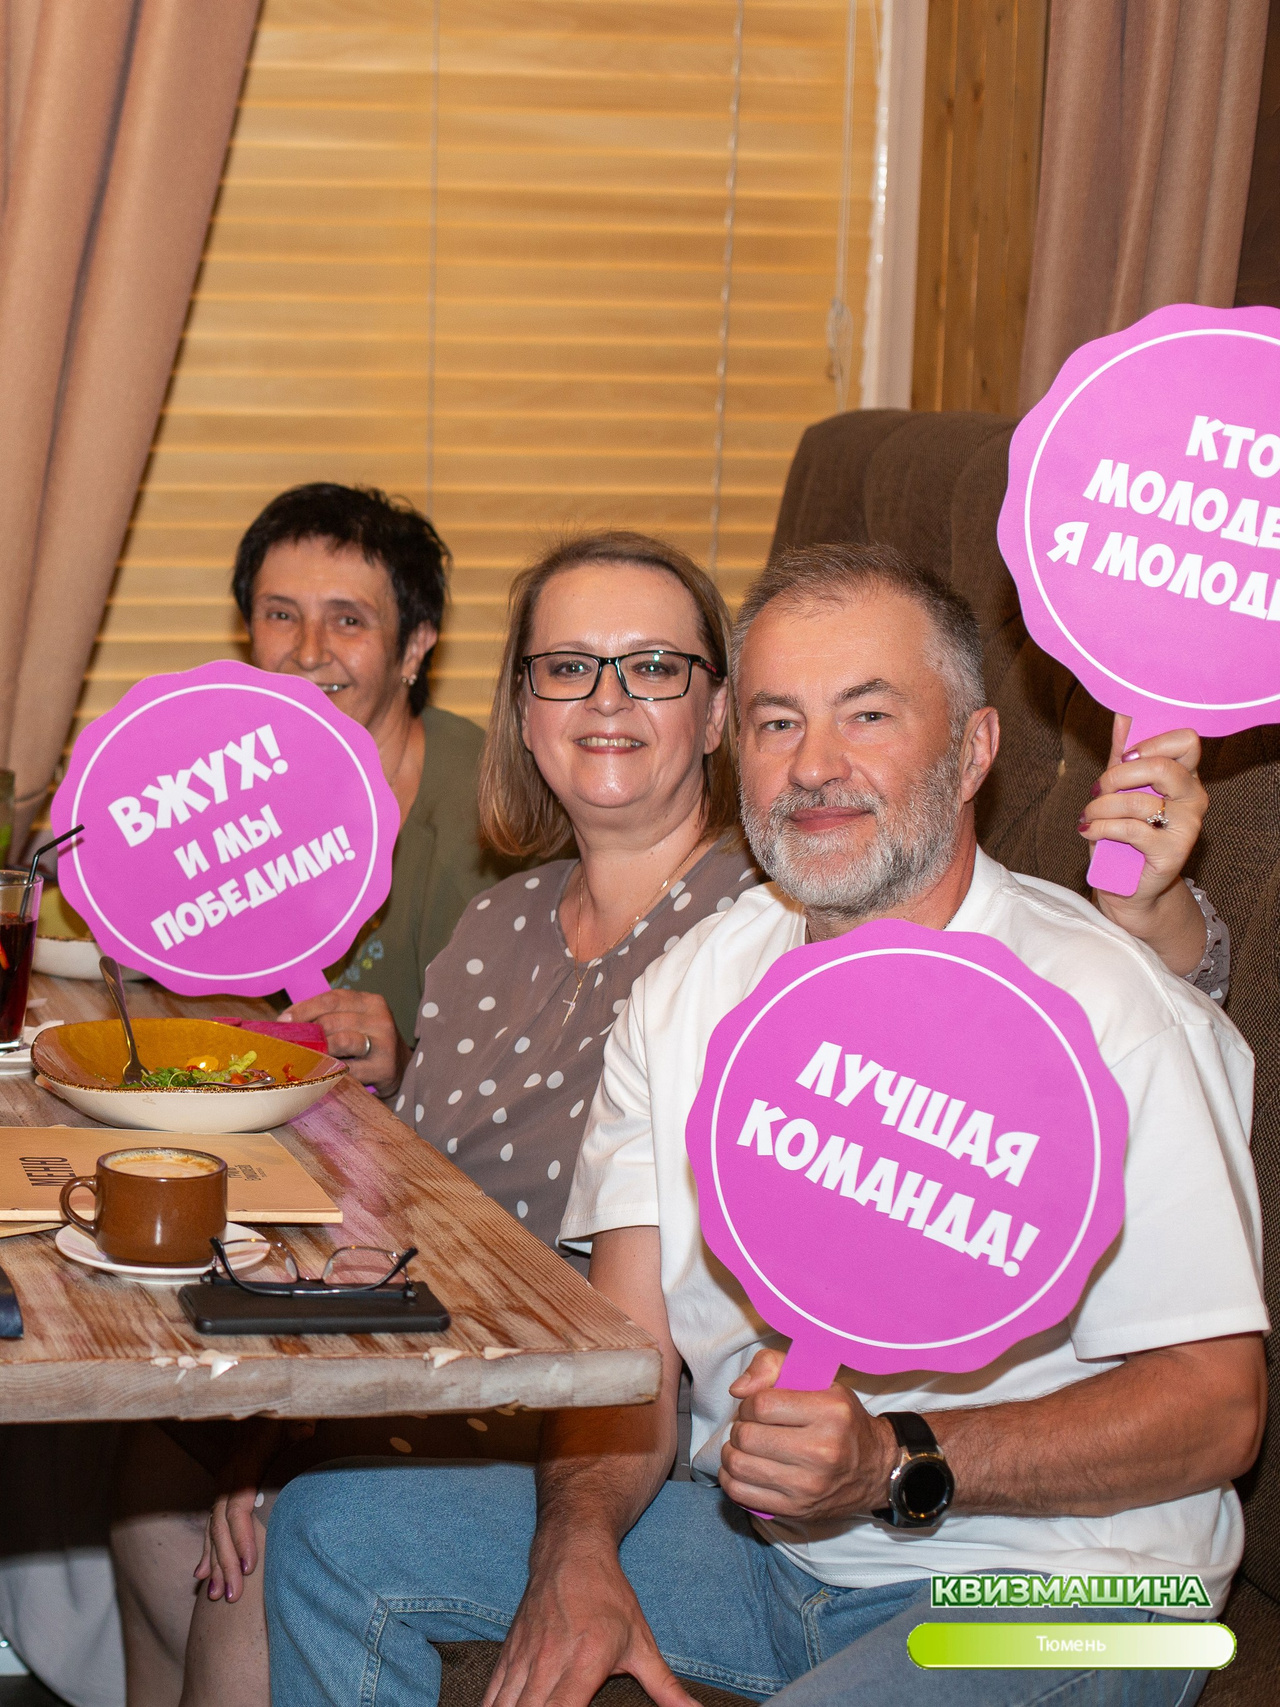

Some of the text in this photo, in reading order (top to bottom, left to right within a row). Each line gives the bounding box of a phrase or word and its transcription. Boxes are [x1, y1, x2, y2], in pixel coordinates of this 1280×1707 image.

[1185, 415, 1280, 478] КТО
[1046, 522, 1089, 566] Я
[108, 724, 288, 847] ВЖУХ!
[174, 804, 282, 880] И МЫ
[151, 825, 355, 951] ПОБЕДИЛИ!
[795, 1041, 1040, 1187] ЛУЧШАЯ
[736, 1099, 1040, 1277] КОМАНДА!
